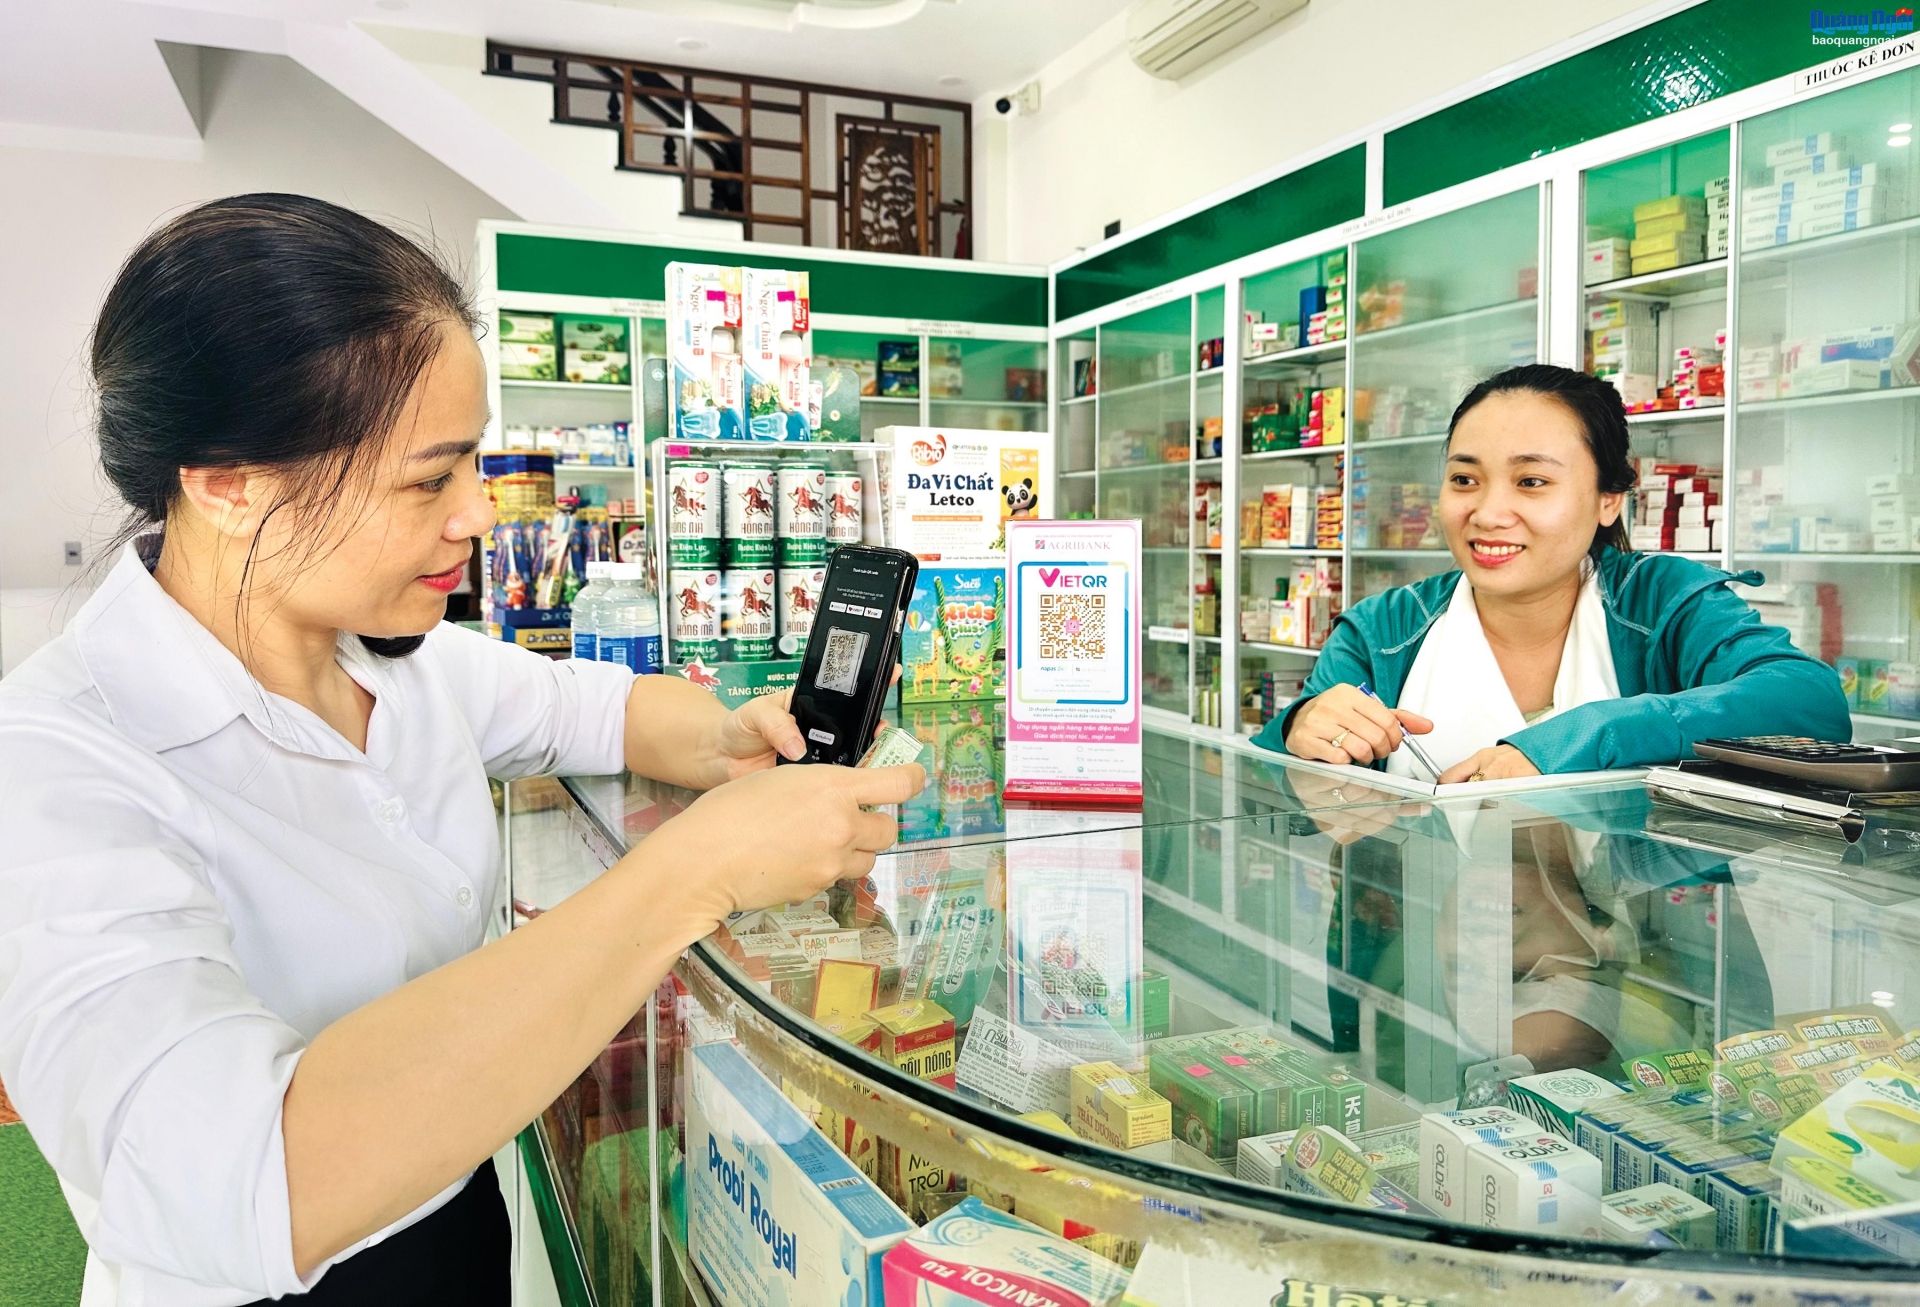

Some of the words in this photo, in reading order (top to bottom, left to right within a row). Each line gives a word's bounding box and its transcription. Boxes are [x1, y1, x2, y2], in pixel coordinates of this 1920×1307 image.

[1804, 59, 1853, 86] THUỐC
[1858, 50, 1878, 69] KÊ
[907, 473, 931, 490] Đa
[932, 474, 951, 490] Vi
[954, 471, 994, 491] Chất
[930, 492, 975, 506] Letco
[1047, 541, 1111, 550] AGRIBANK
[1038, 567, 1108, 588] VIETQR
[727, 687, 752, 697] TĂNG
[804, 937, 827, 950] BABY
[805, 949, 828, 958] spray
[925, 1050, 951, 1074] NÓNG
[1077, 1105, 1094, 1128] THÁI
[1094, 1118, 1120, 1148] DƯƠNG
[1434, 1143, 1445, 1202] COLDi-B
[708, 1131, 745, 1214] Probi
[750, 1181, 797, 1280] Royal
[919, 1260, 957, 1278] FLU
